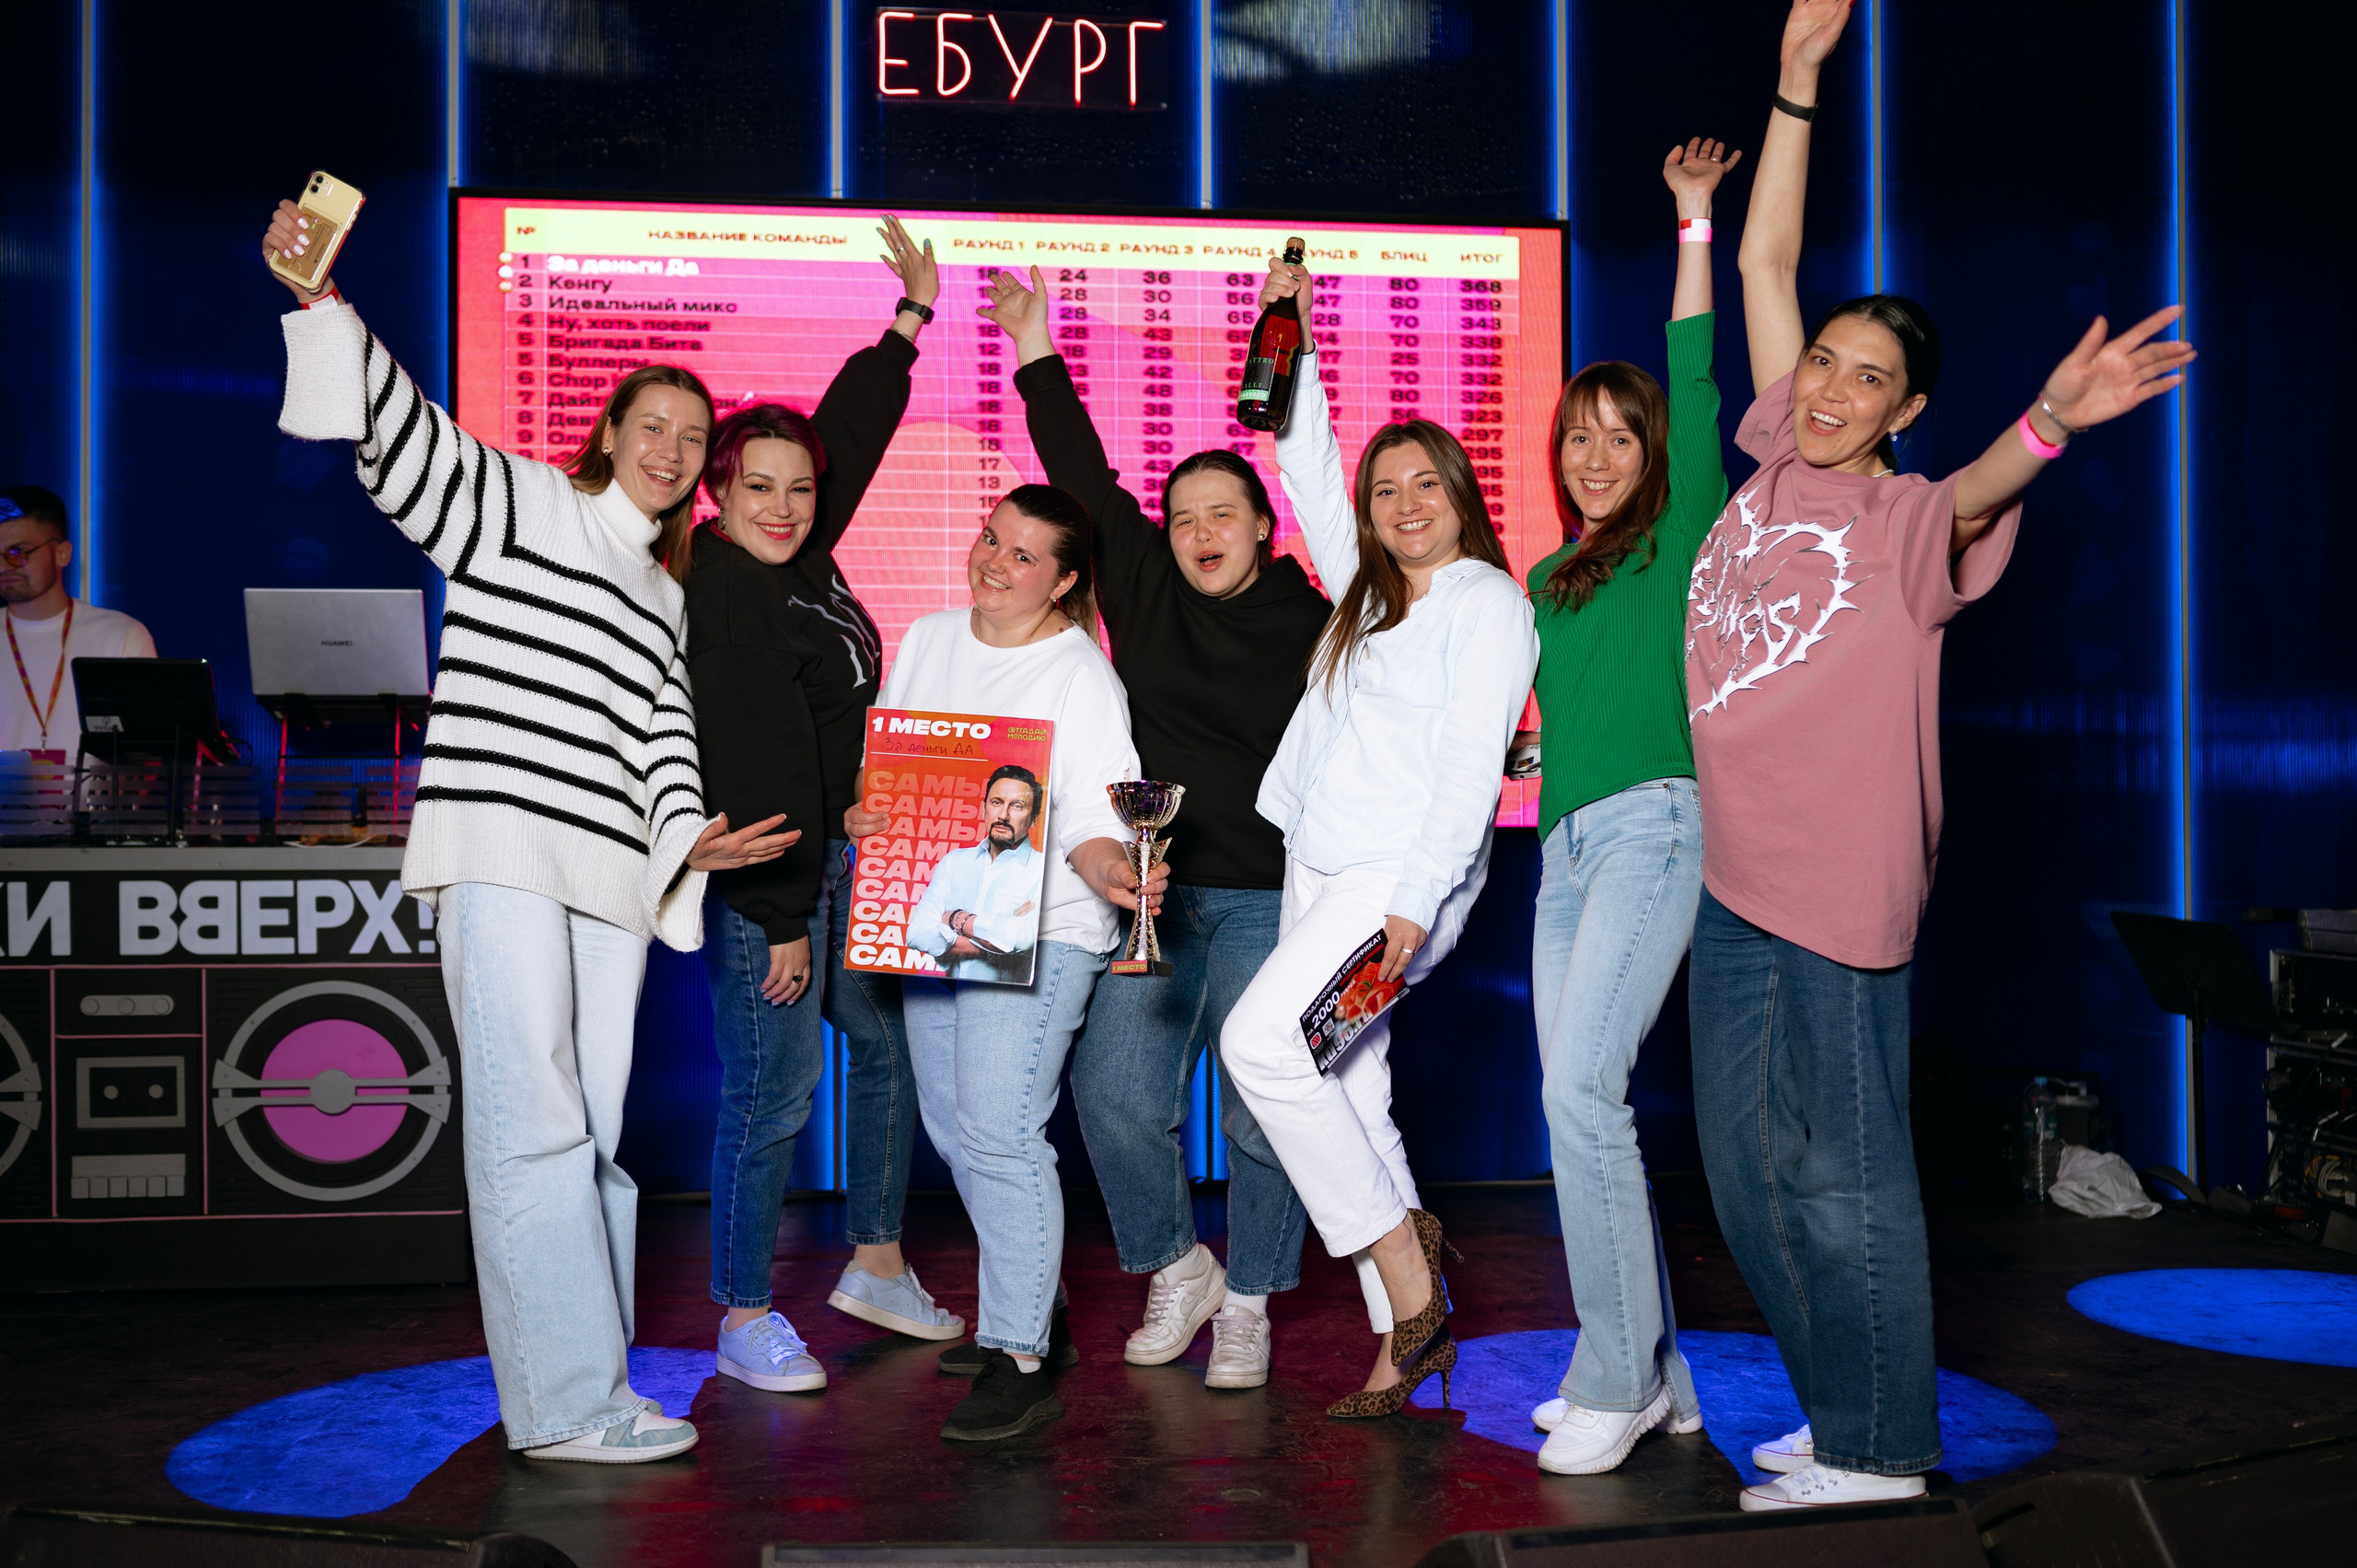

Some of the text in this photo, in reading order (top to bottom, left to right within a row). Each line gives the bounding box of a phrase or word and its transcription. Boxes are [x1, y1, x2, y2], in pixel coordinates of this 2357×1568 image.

[877, 11, 1165, 107] ЕБУРГ
[648, 230, 748, 241] НАЗВАНИЕ
[753, 232, 847, 245] КОМАНДЫ
[953, 239, 1014, 250] РАУНД
[1037, 240, 1096, 252] РАУНД
[1100, 243, 1110, 252] 2
[1120, 243, 1179, 254] РАУНД
[1185, 245, 1193, 254] 3
[1203, 246, 1262, 257] РАУНД
[1381, 250, 1429, 262] БЛИЦ
[1460, 253, 1504, 263] ИТОГ
[522, 256, 529, 267] 1
[547, 255, 578, 273] За
[581, 259, 663, 274] деньги
[665, 258, 699, 276] Да
[1060, 269, 1087, 282] 24
[1144, 271, 1171, 284] 36
[1226, 273, 1254, 286] 63
[1390, 278, 1419, 291] 80
[1461, 280, 1502, 293] 368
[519, 274, 532, 287] 2
[550, 276, 612, 292] Кенгу
[1061, 288, 1086, 301] 28
[1144, 290, 1171, 303] 30
[1227, 293, 1254, 305] 56
[1390, 296, 1418, 309] 80
[1462, 298, 1502, 311] 359
[520, 294, 532, 307] 3
[550, 296, 676, 311] Идеальный
[683, 302, 737, 313] микс
[1060, 308, 1087, 320] 28
[1144, 309, 1170, 321] 34
[1227, 311, 1254, 323] 65
[1390, 316, 1418, 328] 70
[1462, 318, 1502, 330] 343
[519, 314, 532, 326] 4
[549, 316, 582, 331] Ну,
[588, 319, 637, 330] хоть
[644, 320, 710, 331] поели
[979, 325, 1000, 337] 18
[1061, 326, 1087, 339] 28
[1144, 329, 1171, 341] 43
[1391, 334, 1419, 346] 70
[1462, 336, 1502, 349] 338
[519, 332, 532, 345] 5
[550, 335, 643, 351] Бригада
[649, 337, 702, 351] Бита
[979, 343, 999, 355] 12
[1063, 345, 1085, 357] 18
[1144, 346, 1171, 359] 29
[1392, 353, 1418, 365] 25
[1462, 354, 1502, 367] 332
[519, 353, 532, 366] 5
[979, 363, 1000, 375] 18
[1144, 366, 1171, 378] 42
[1391, 371, 1419, 384] 70
[1462, 373, 1502, 386] 332
[518, 372, 532, 385] 6
[549, 374, 606, 389] Chop
[979, 381, 1000, 394] 18
[1144, 384, 1171, 397] 48
[1391, 389, 1419, 402] 80
[1462, 391, 1502, 404] 326
[519, 391, 532, 403] 7
[548, 392, 608, 408] Дайт
[979, 401, 1000, 413] 18
[1145, 403, 1171, 416] 38
[1462, 410, 1502, 423] 323
[518, 411, 532, 424] 8
[979, 419, 1000, 432] 18
[1144, 423, 1172, 435] 30
[1462, 429, 1503, 442] 297
[518, 430, 532, 443] 9
[979, 438, 1000, 450] 18
[1144, 441, 1172, 453] 30
[980, 458, 1000, 470] 17
[1144, 460, 1172, 472] 43
[1476, 466, 1503, 479] 95
[980, 477, 1000, 489] 13
[872, 716, 992, 739] 1 МЕСТО
[884, 737, 903, 752] За
[877, 816, 988, 842] АМЫ
[861, 835, 960, 861] САМ
[0, 880, 71, 958] И
[849, 944, 946, 972] САМ
[1117, 963, 1146, 971] МЕСТО
[1302, 934, 1382, 1022] ПОДАРОЧНЫЙ СЕРТИФИКАТ
[1312, 991, 1341, 1029] 2000
